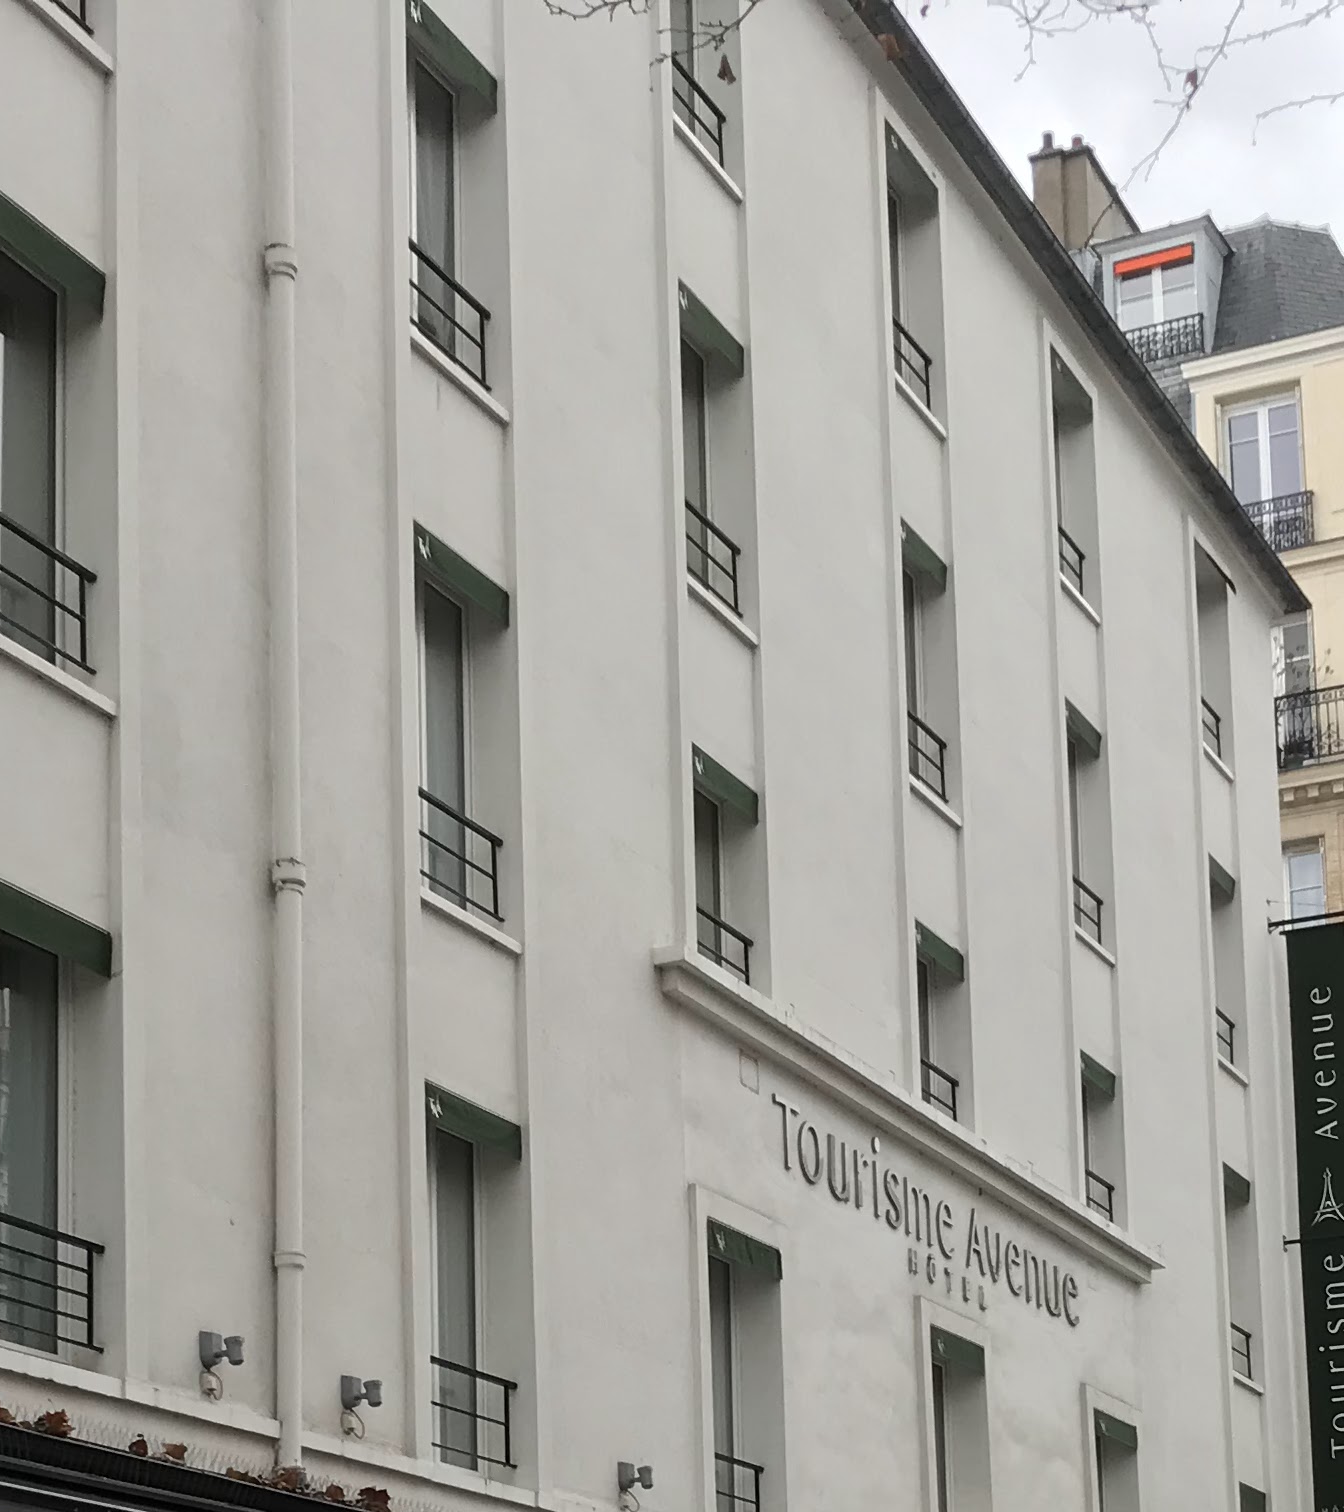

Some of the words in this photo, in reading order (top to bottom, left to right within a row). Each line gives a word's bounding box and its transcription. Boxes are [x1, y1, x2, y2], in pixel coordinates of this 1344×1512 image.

[1309, 985, 1340, 1140] Avenue
[771, 1093, 955, 1260] Tourisme
[965, 1208, 1080, 1328] Avenue
